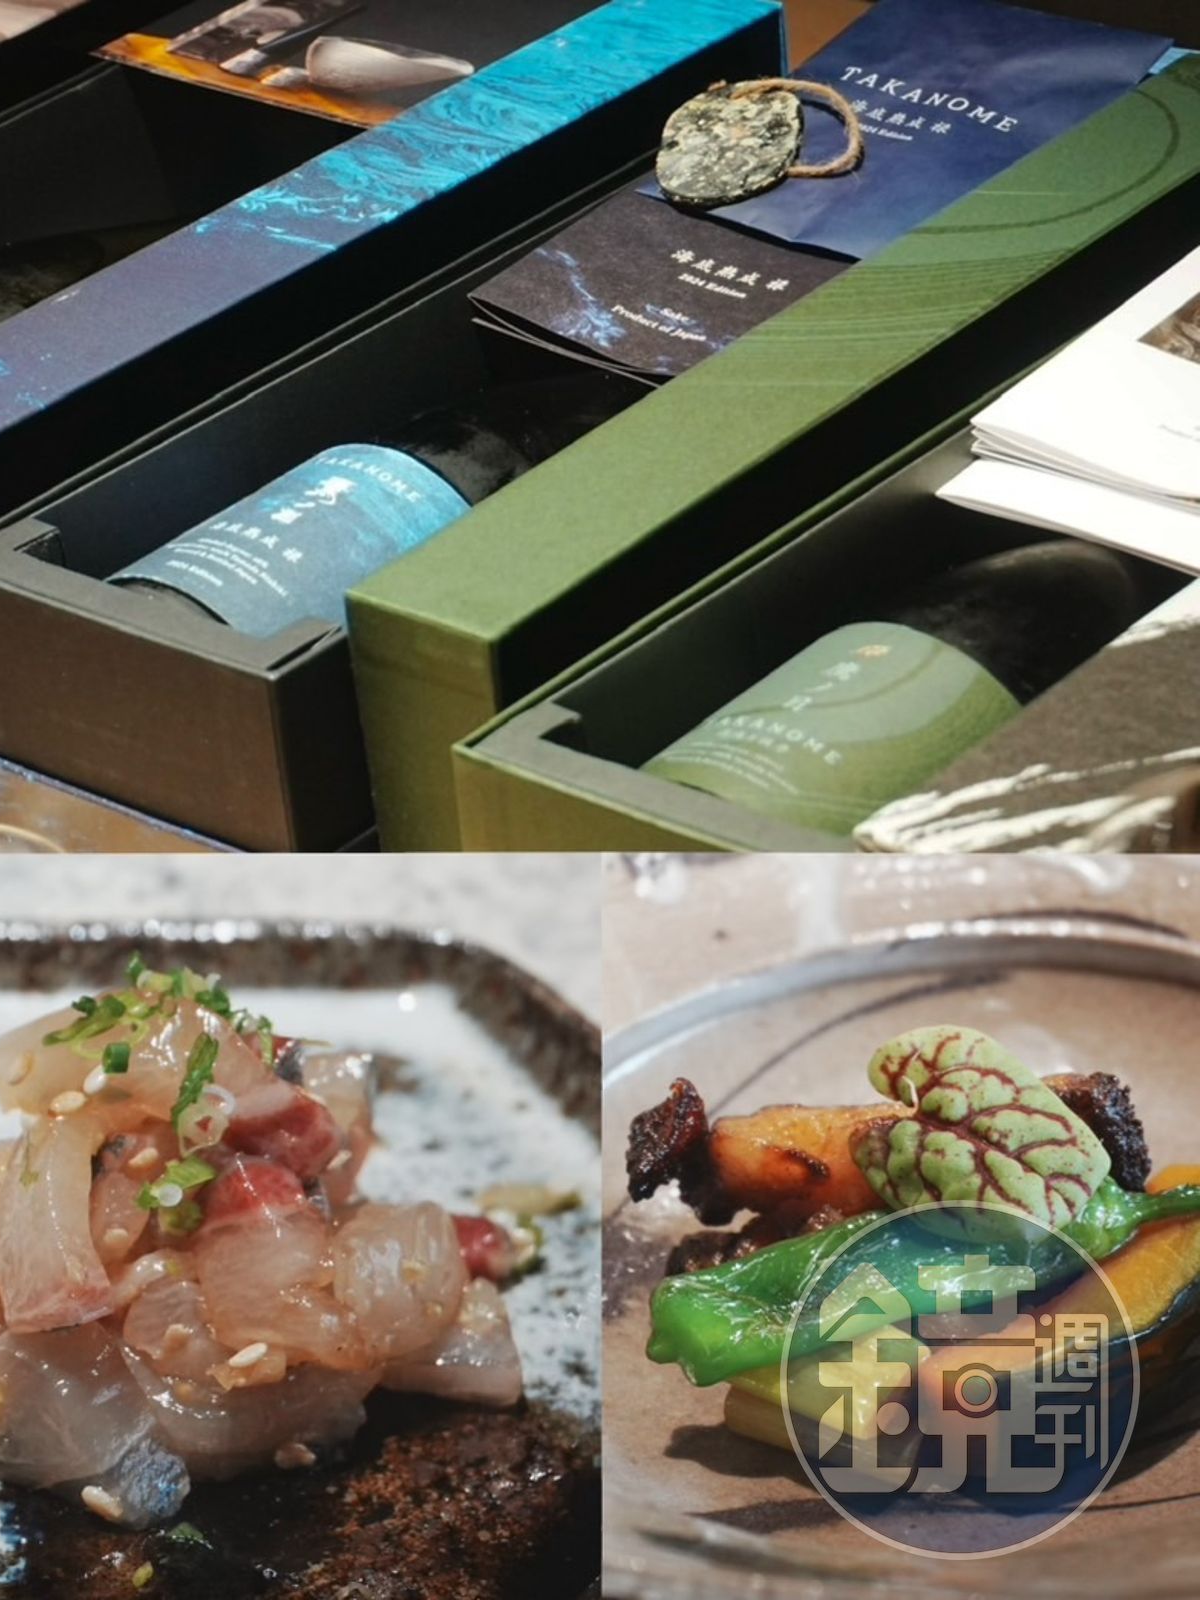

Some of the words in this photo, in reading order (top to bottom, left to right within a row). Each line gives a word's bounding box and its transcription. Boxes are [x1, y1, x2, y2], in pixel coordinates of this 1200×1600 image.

[840, 66, 1019, 134] TAKANOME
[611, 304, 659, 329] Product
[658, 324, 676, 334] of
[668, 325, 707, 341] Japan
[713, 714, 843, 766] AKANOME
